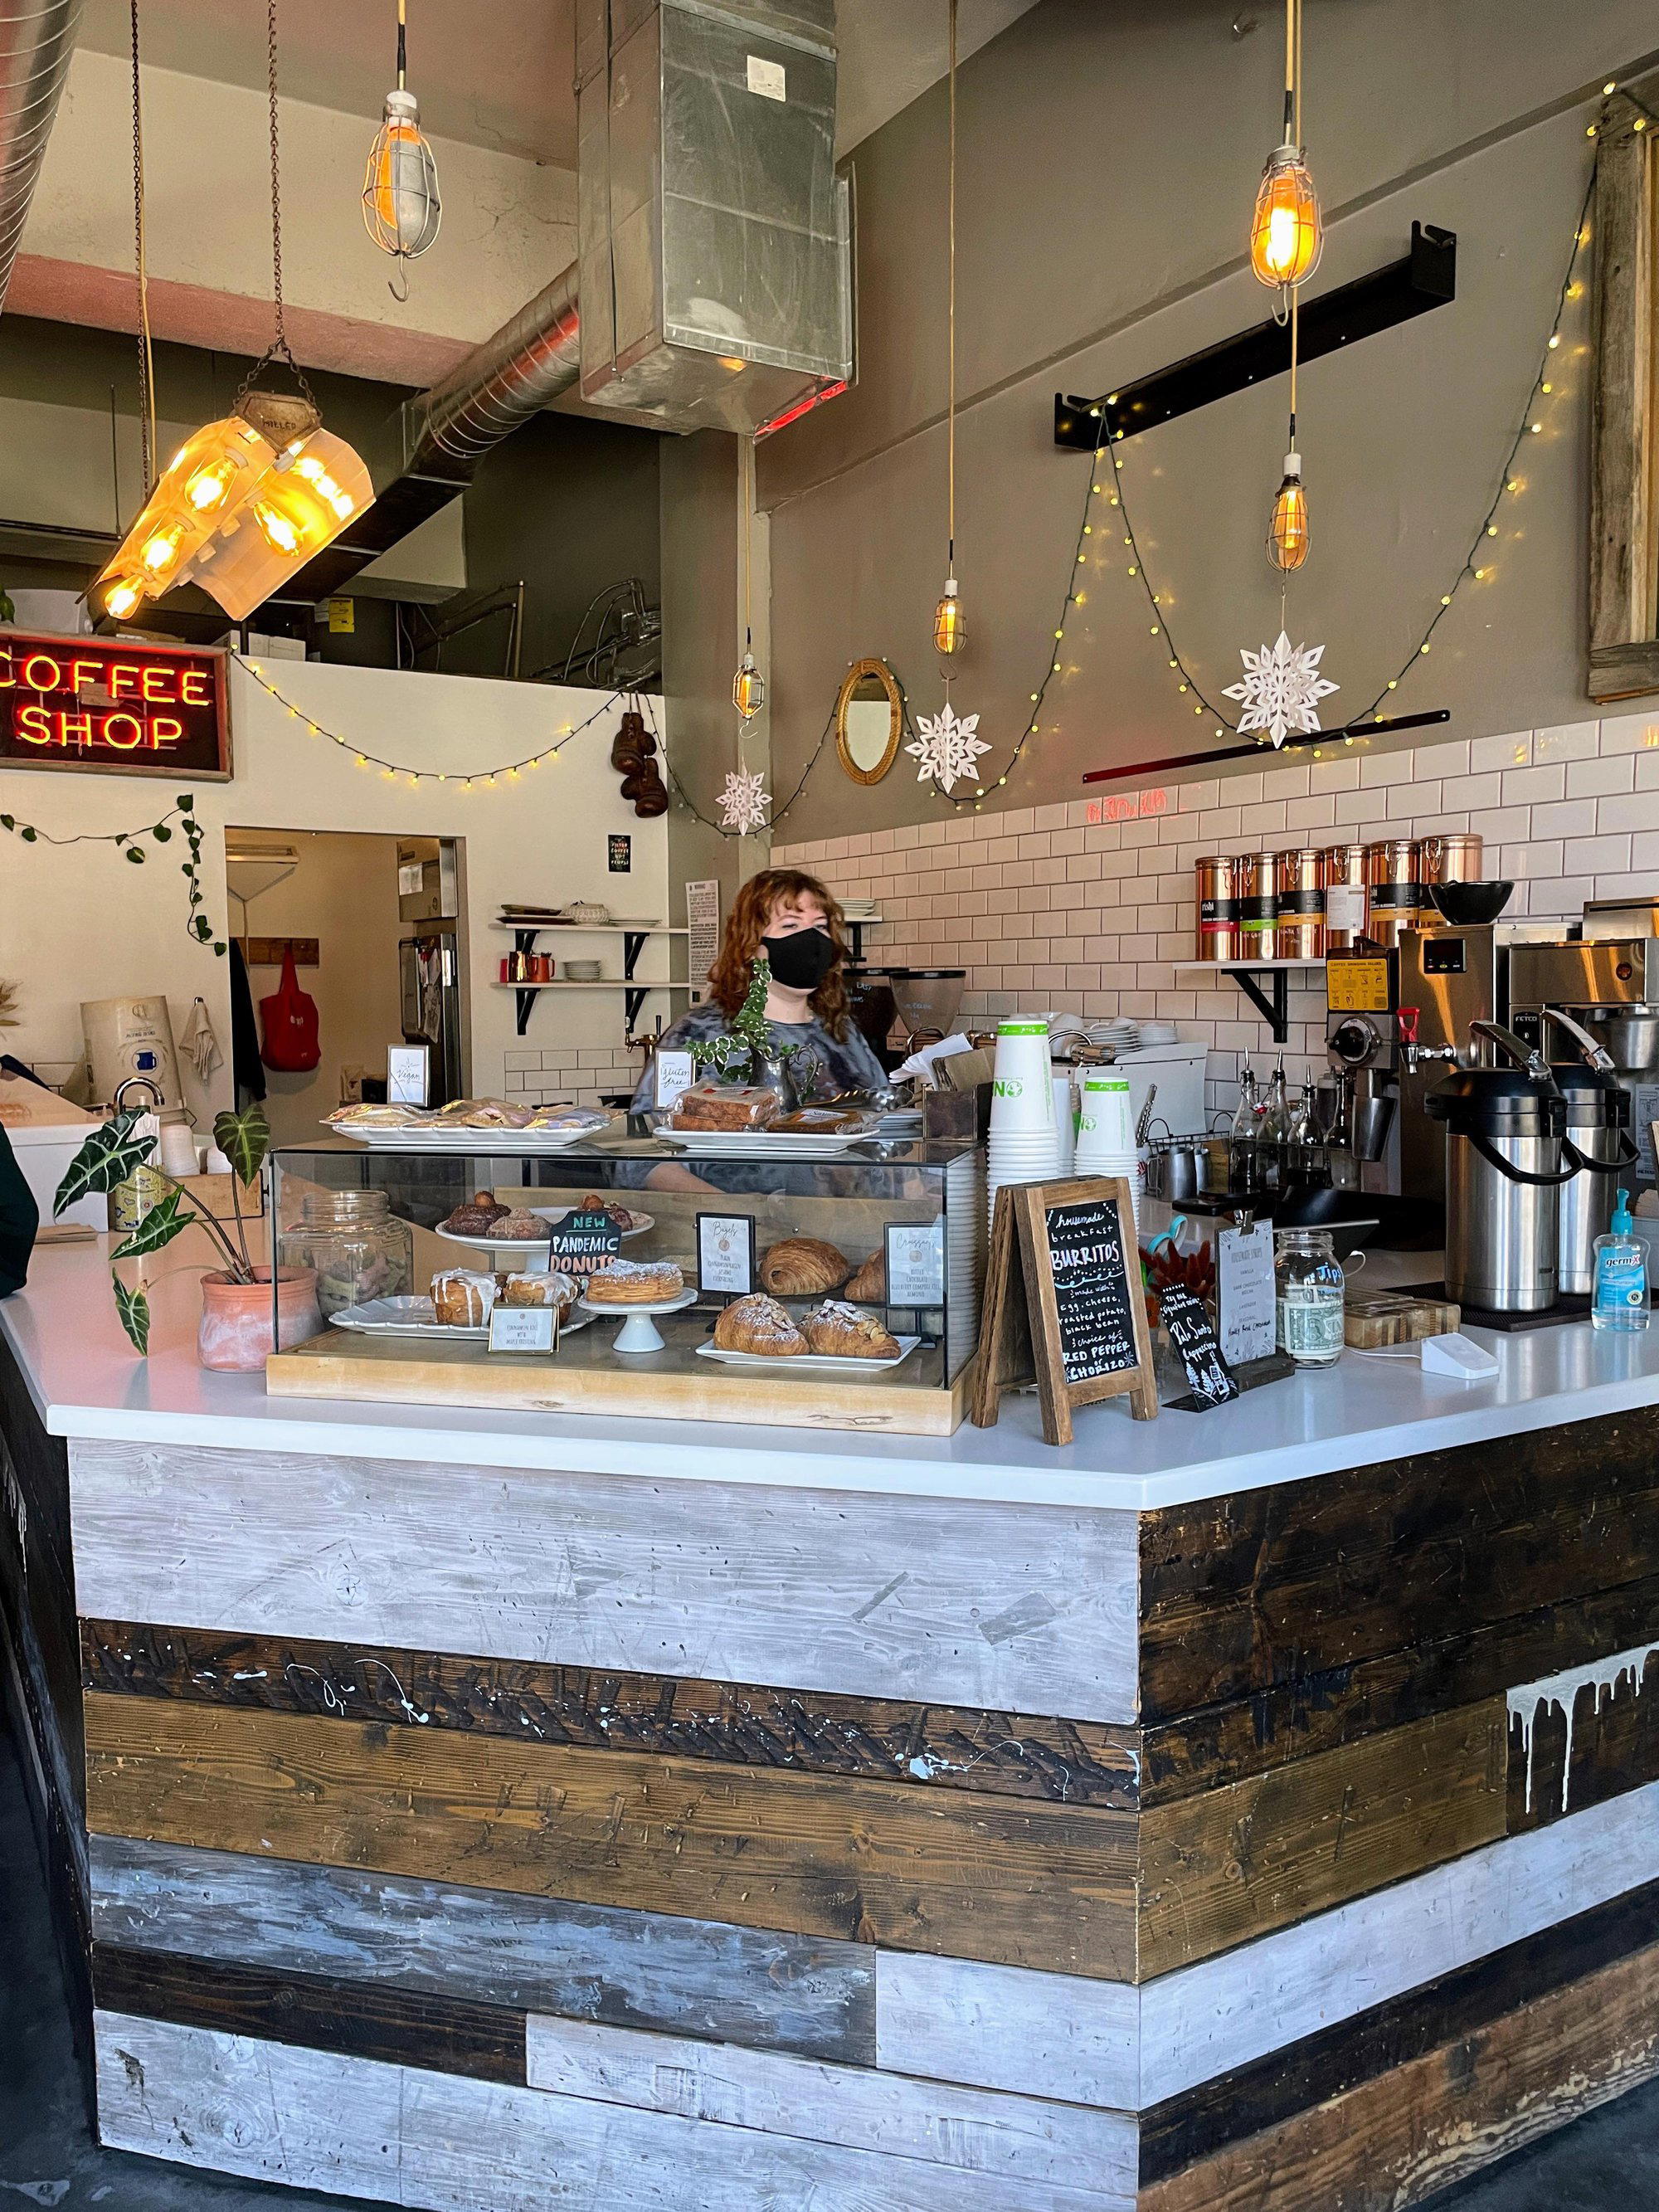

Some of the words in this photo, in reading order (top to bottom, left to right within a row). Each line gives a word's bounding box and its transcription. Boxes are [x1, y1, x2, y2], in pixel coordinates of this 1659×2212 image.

[20, 706, 182, 750] SHOP
[573, 1216, 606, 1228] NEW
[1051, 1225, 1113, 1242] breakfast
[552, 1235, 619, 1253] PANDEMIC
[1049, 1240, 1119, 1270] BURRITOS
[1074, 1288, 1094, 1296] made
[1058, 1311, 1095, 1325] roasted
[1066, 1323, 1092, 1335] black
[1095, 1319, 1120, 1329] bean
[1078, 1334, 1106, 1347] choice
[1108, 1332, 1119, 1342] of
[1063, 1351, 1087, 1365] RED
[1091, 1341, 1130, 1358] PEPPER
[1070, 1359, 1125, 1381] CHORIZO
